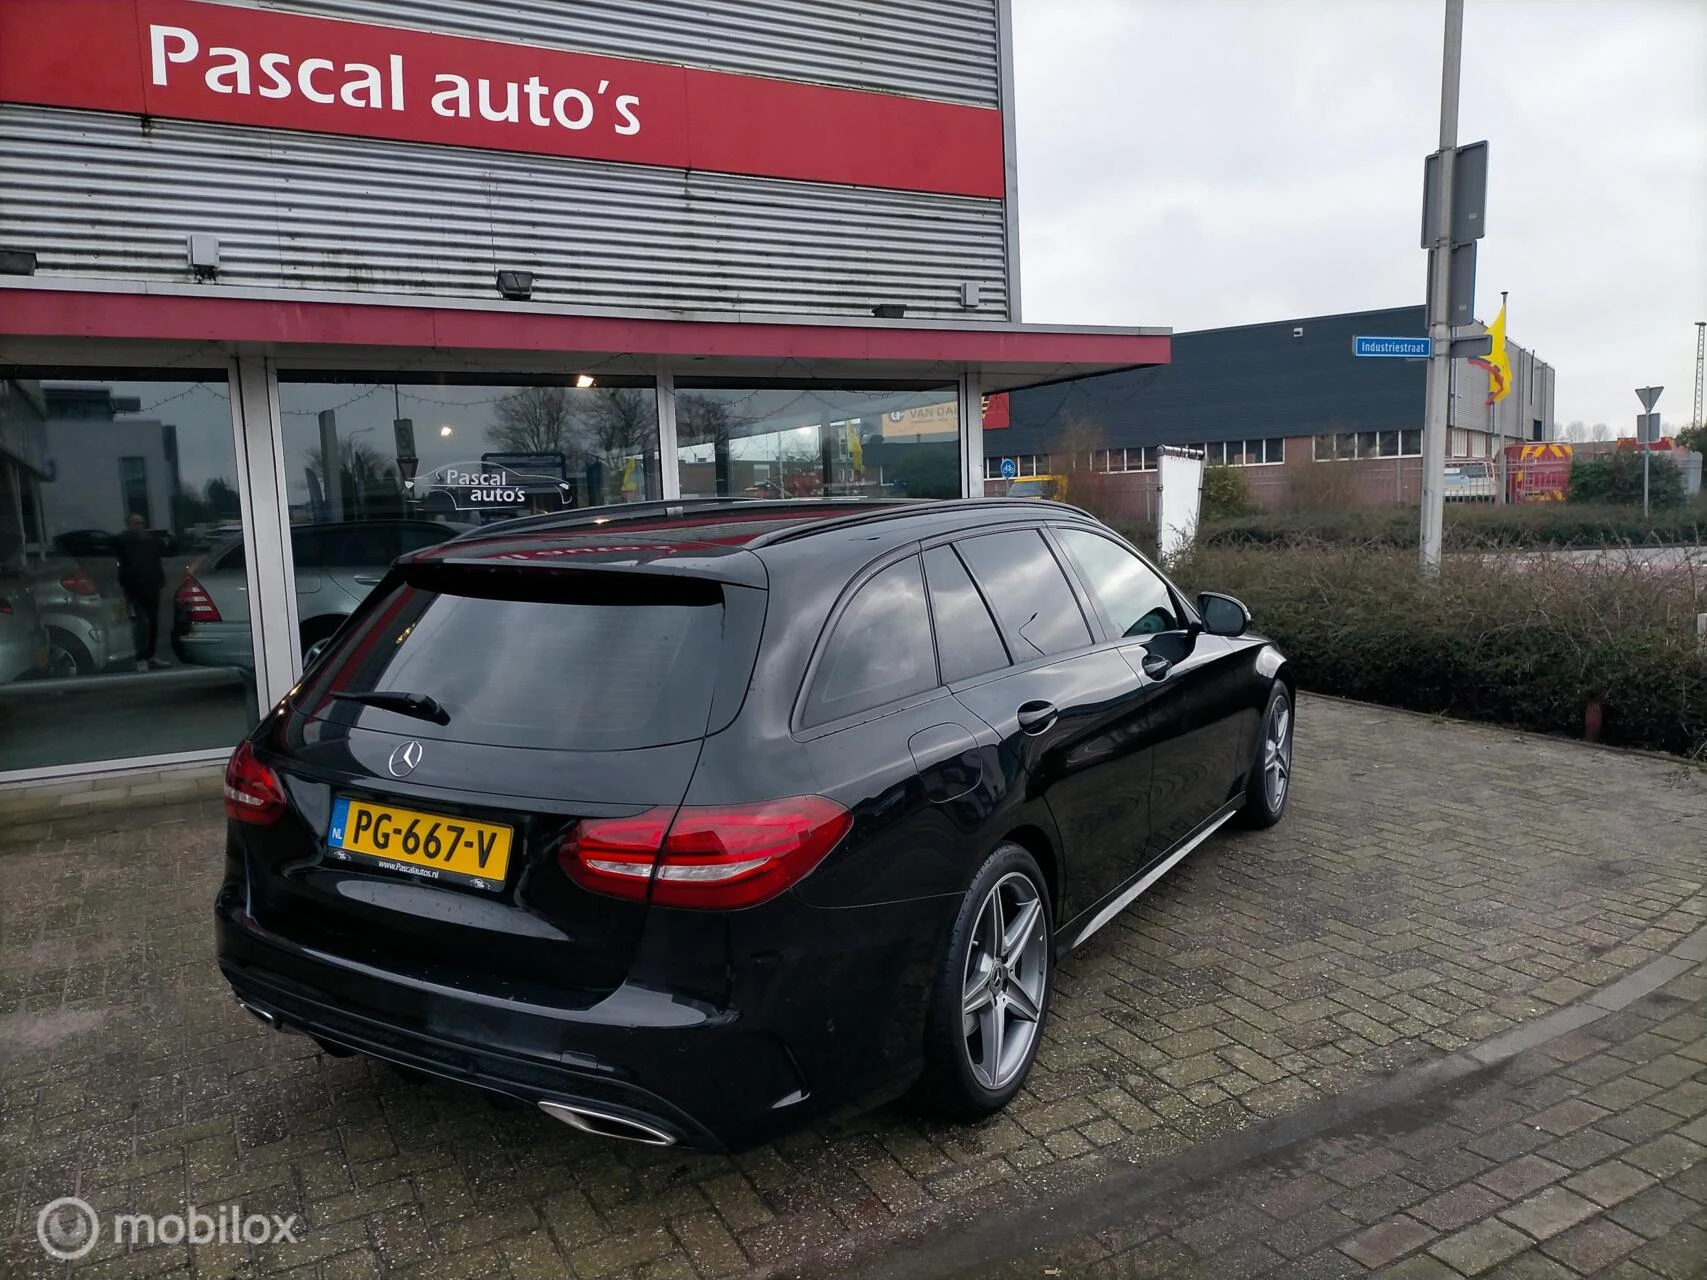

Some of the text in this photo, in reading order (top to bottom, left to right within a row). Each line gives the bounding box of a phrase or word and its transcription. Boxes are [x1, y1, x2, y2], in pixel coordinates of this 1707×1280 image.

[149, 23, 642, 137] Pascal auto's
[1361, 341, 1425, 353] Industriestraat
[910, 407, 934, 419] VAN
[446, 469, 506, 486] Pascal
[470, 487, 526, 502] auto's
[332, 808, 498, 869] NL PG-667-V
[378, 860, 440, 879] www.Pascalautos.nl
